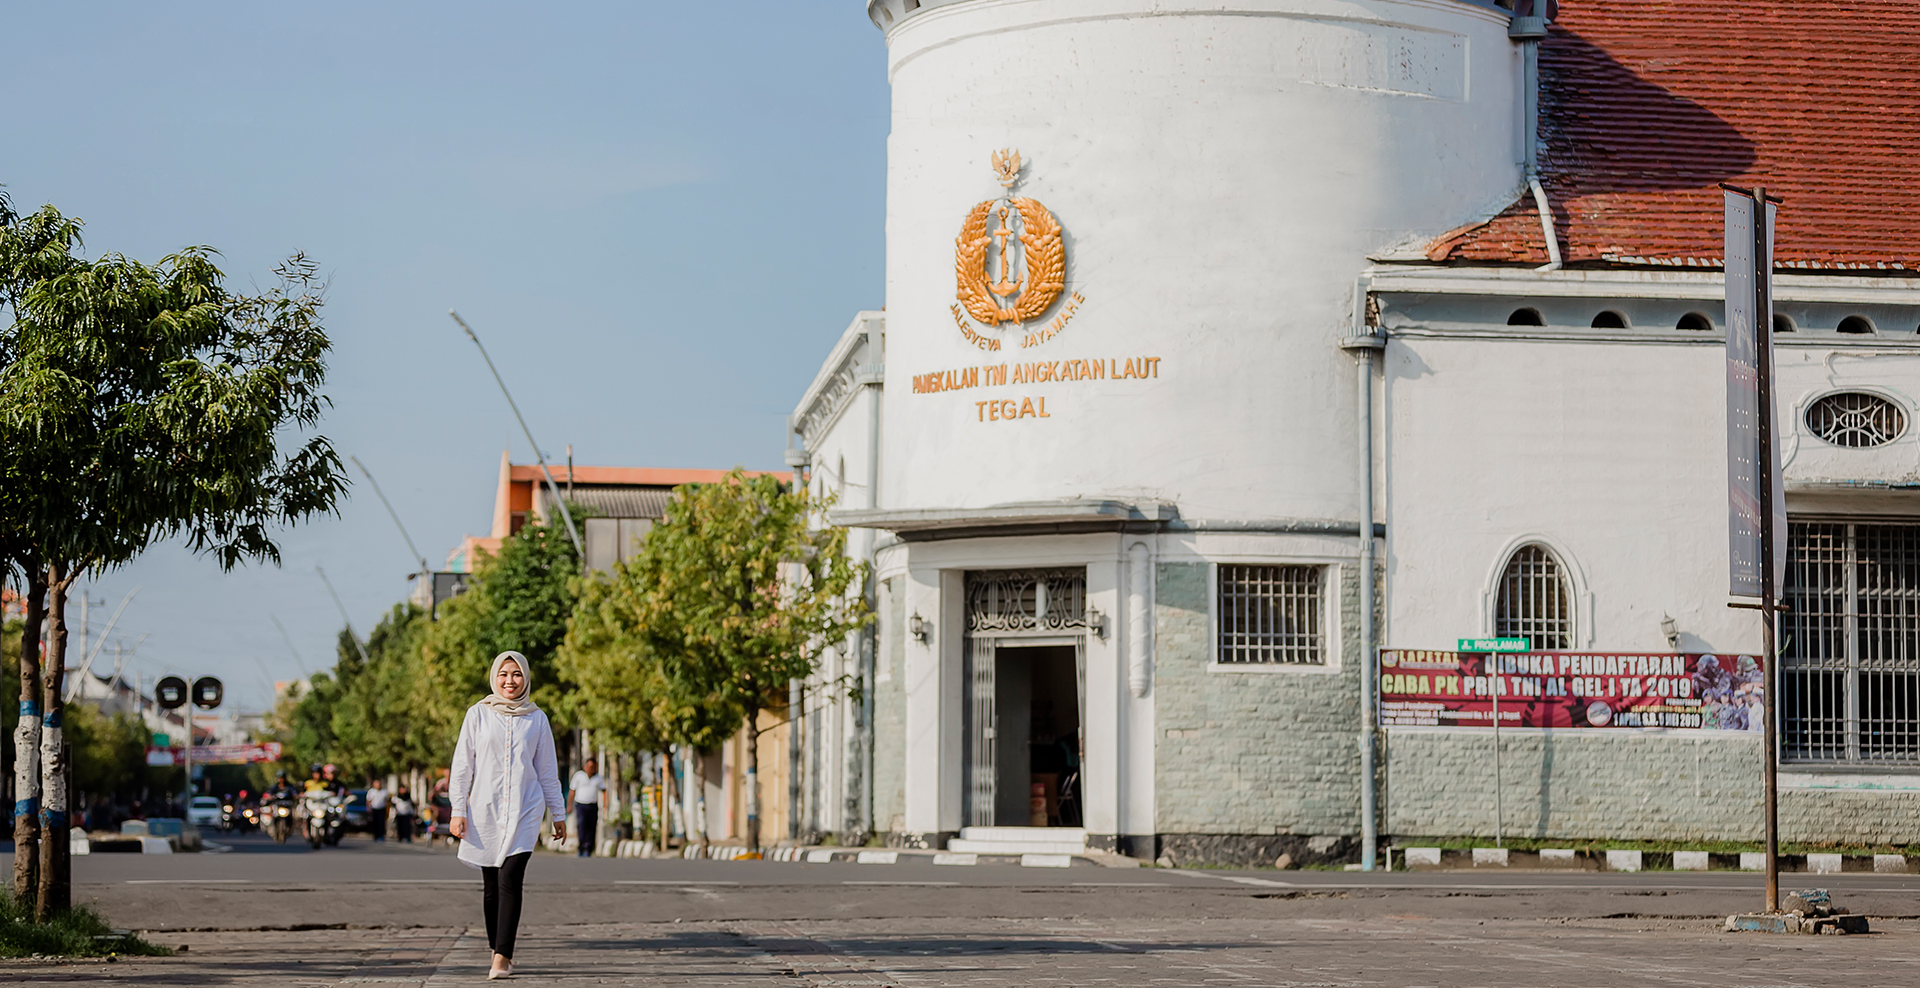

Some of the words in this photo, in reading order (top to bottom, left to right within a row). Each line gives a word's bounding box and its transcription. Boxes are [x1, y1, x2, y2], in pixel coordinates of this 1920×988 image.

[950, 302, 1001, 351] JALESVEVA
[1020, 291, 1085, 348] JAYAMAHE
[912, 367, 978, 394] PANGKALAN
[983, 364, 1008, 386] TNI
[1012, 359, 1105, 384] ANGKATAN
[1110, 356, 1161, 380] LAUT
[975, 396, 1050, 422] TEGAL
[1474, 639, 1525, 652] PROKLAMASI
[1400, 650, 1460, 664] LAPETAL
[1559, 655, 1686, 676] PENDAFTARAN
[1381, 674, 1431, 695] CABA
[1434, 675, 1460, 696] PK
[1463, 676, 1507, 697] PRIA
[1510, 676, 1542, 697] TNI
[1546, 676, 1568, 697] AL
[1571, 677, 1605, 697] GEL
[1608, 677, 1616, 697] I
[1620, 677, 1642, 697] TA
[1646, 677, 1692, 698] 2019
[1619, 712, 1642, 727] APRIL
[1680, 713, 1700, 728] 2019
